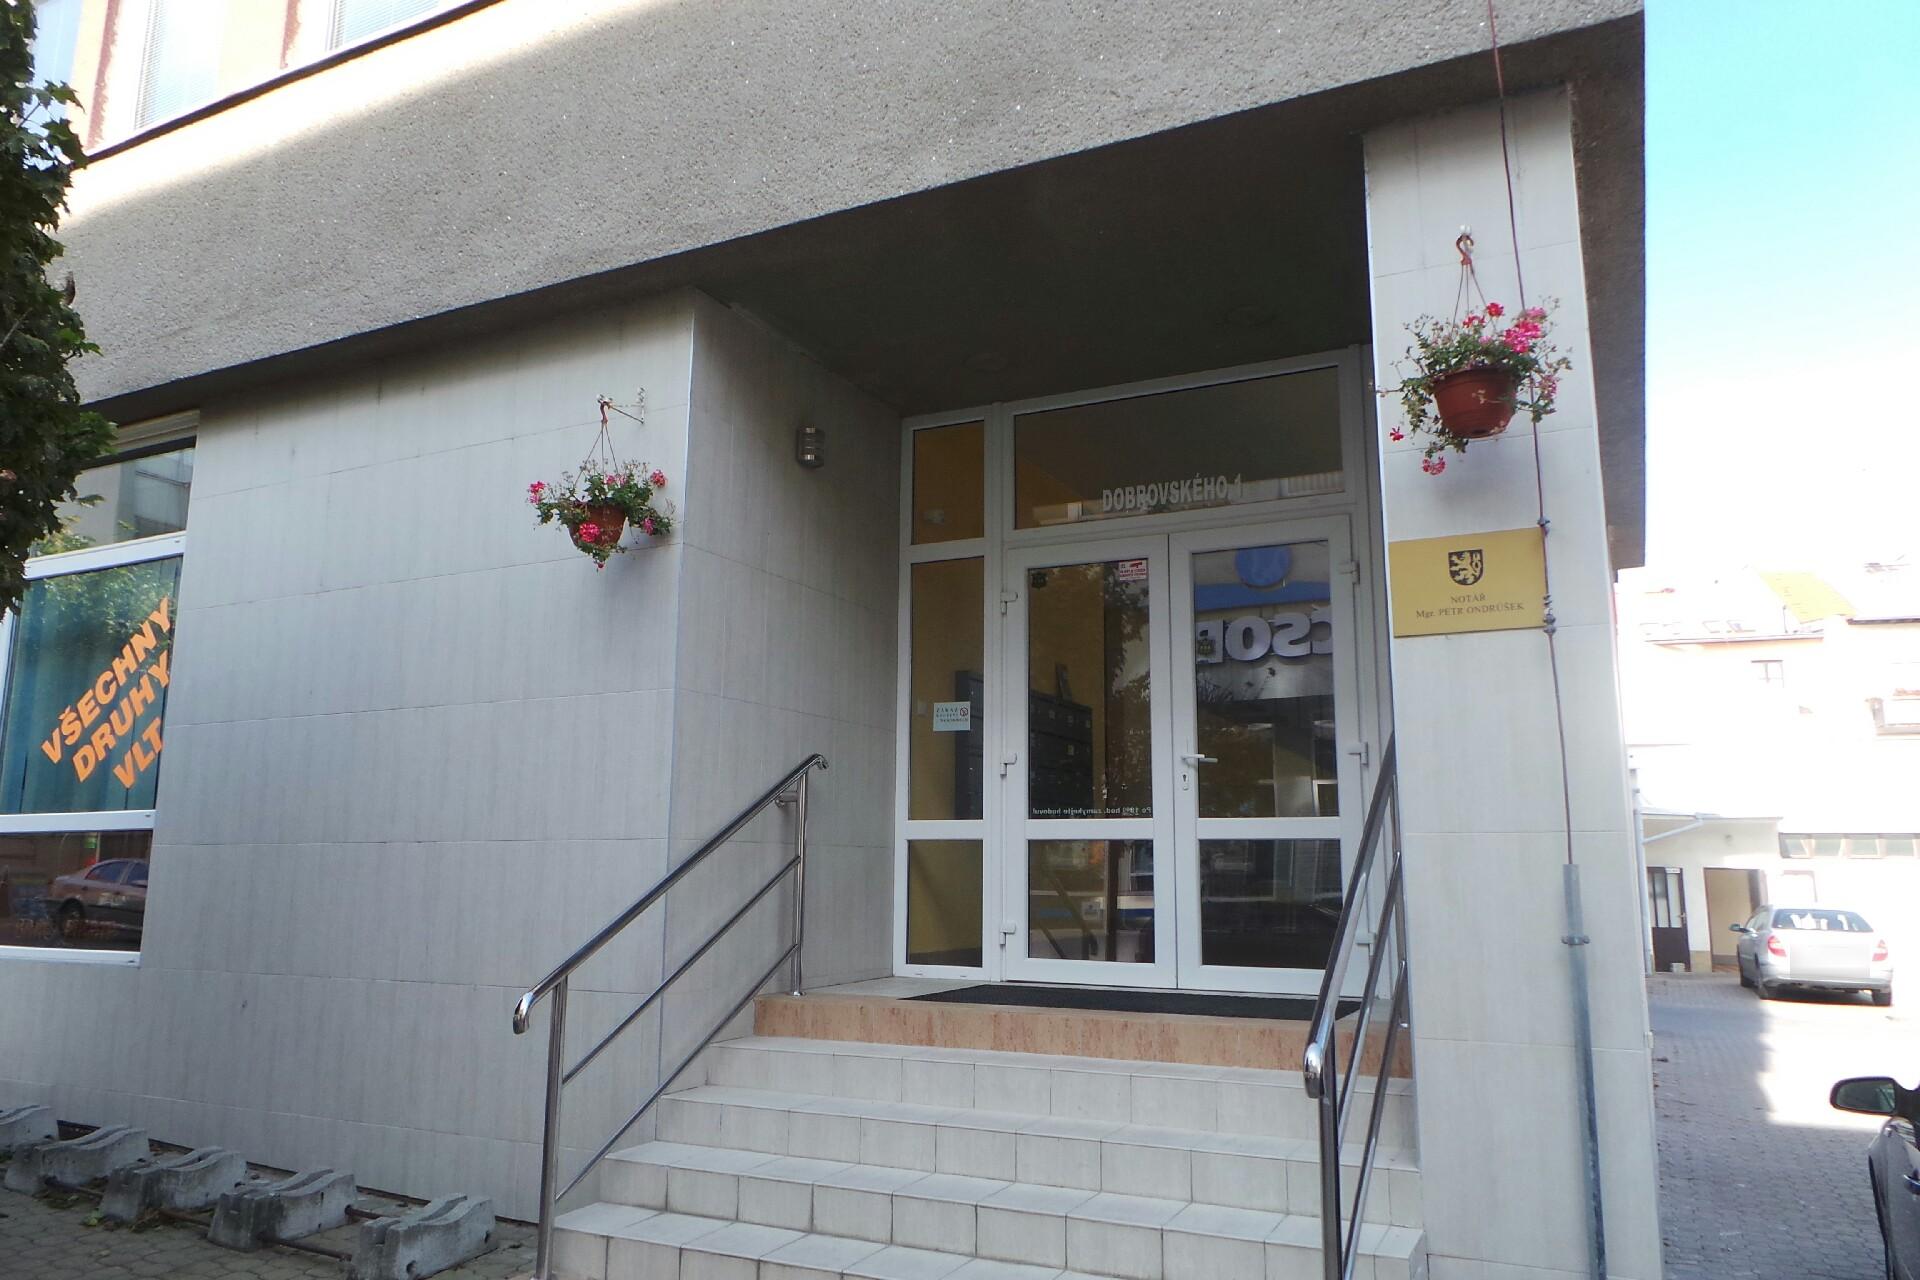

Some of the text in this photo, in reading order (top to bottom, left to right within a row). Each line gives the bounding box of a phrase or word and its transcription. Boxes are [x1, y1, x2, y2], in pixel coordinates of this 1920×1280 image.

[1103, 473, 1242, 512] DOBROVSKÉHO 1
[1416, 609, 1436, 620] Mgr.
[1439, 607, 1463, 617] PETR
[41, 597, 172, 765] VŠECHNY
[72, 650, 170, 783] DRUHY
[113, 717, 163, 789] VLT
